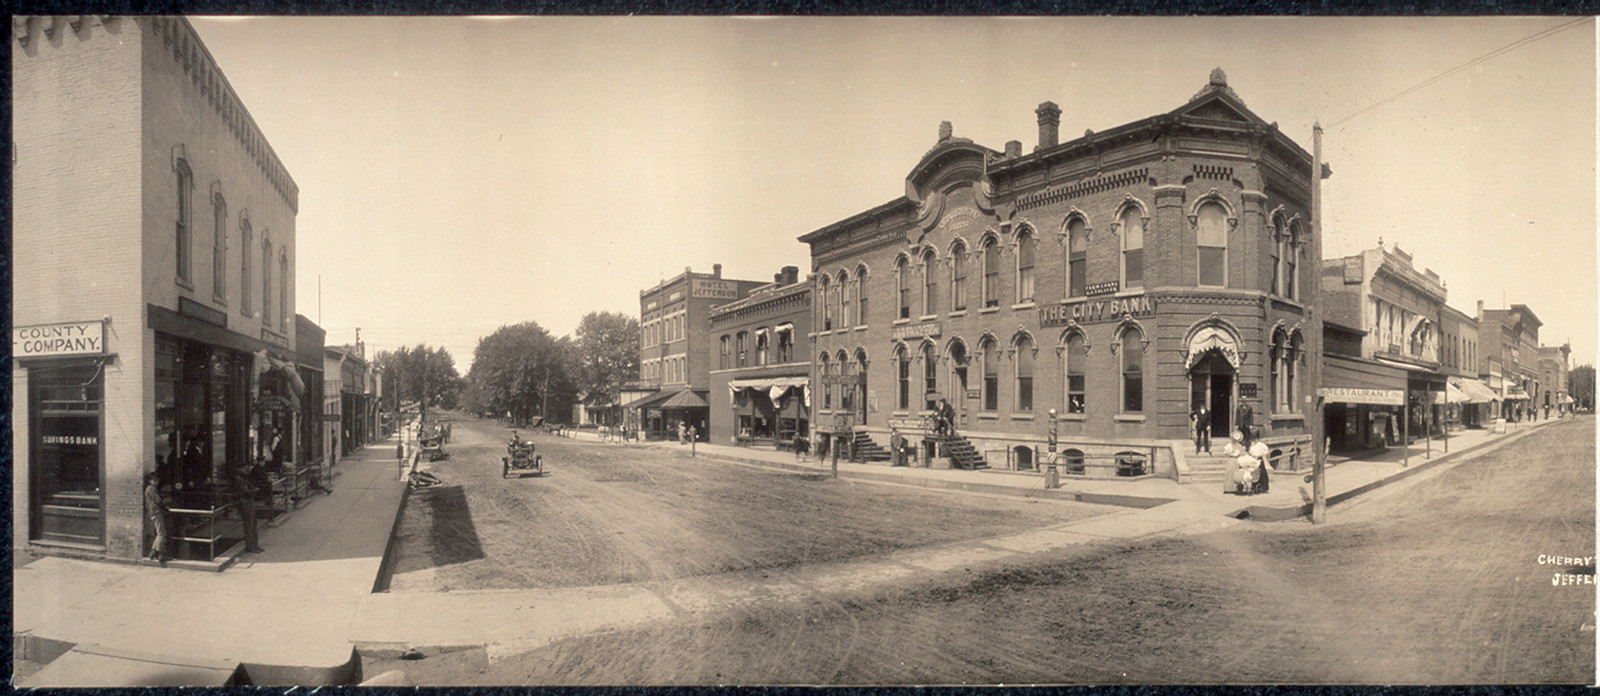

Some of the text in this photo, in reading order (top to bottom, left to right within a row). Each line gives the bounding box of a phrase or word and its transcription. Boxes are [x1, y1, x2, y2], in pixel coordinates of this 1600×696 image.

[700, 281, 728, 289] HOTEL
[693, 288, 736, 298] JEFFERSON
[1042, 297, 1151, 320] THE CITY BANK
[19, 325, 88, 339] COUNTY
[24, 337, 100, 353] COMPANY.
[1327, 388, 1389, 398] RESTAURANT
[76, 436, 98, 445] BANK
